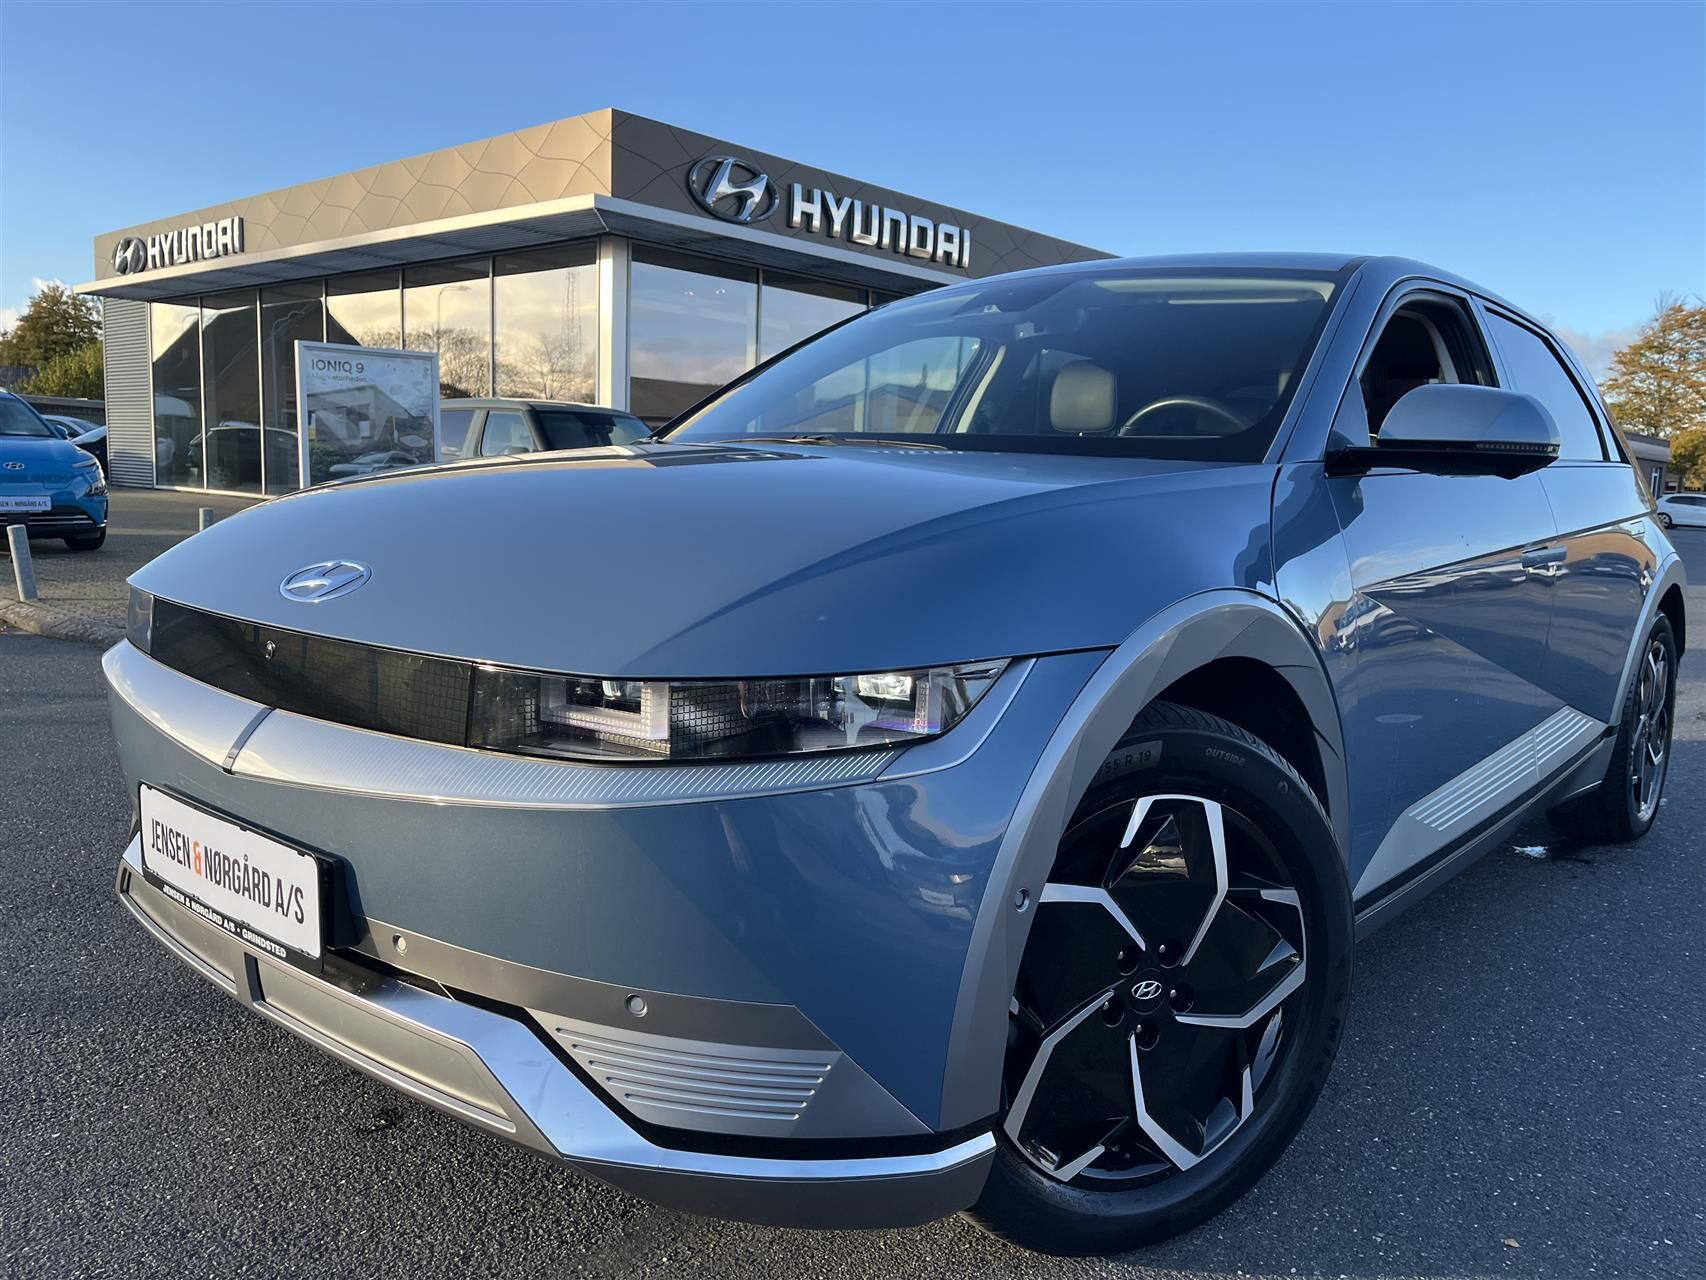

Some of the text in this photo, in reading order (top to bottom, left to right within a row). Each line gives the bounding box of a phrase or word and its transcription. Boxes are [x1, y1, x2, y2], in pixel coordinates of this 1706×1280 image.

[147, 216, 243, 269] HYUNDAI
[788, 182, 970, 268] HYUNDAI
[311, 359, 365, 374] IONIQ 9
[1124, 754, 1133, 767] R
[1138, 750, 1152, 763] 19
[1205, 747, 1246, 766] OUTSIDE
[151, 817, 305, 924] JENSEN & NØRGÅRD A/S
[162, 884, 185, 903] JENSEN
[223, 919, 235, 932] A/S
[242, 928, 287, 958] GRINDSTED
